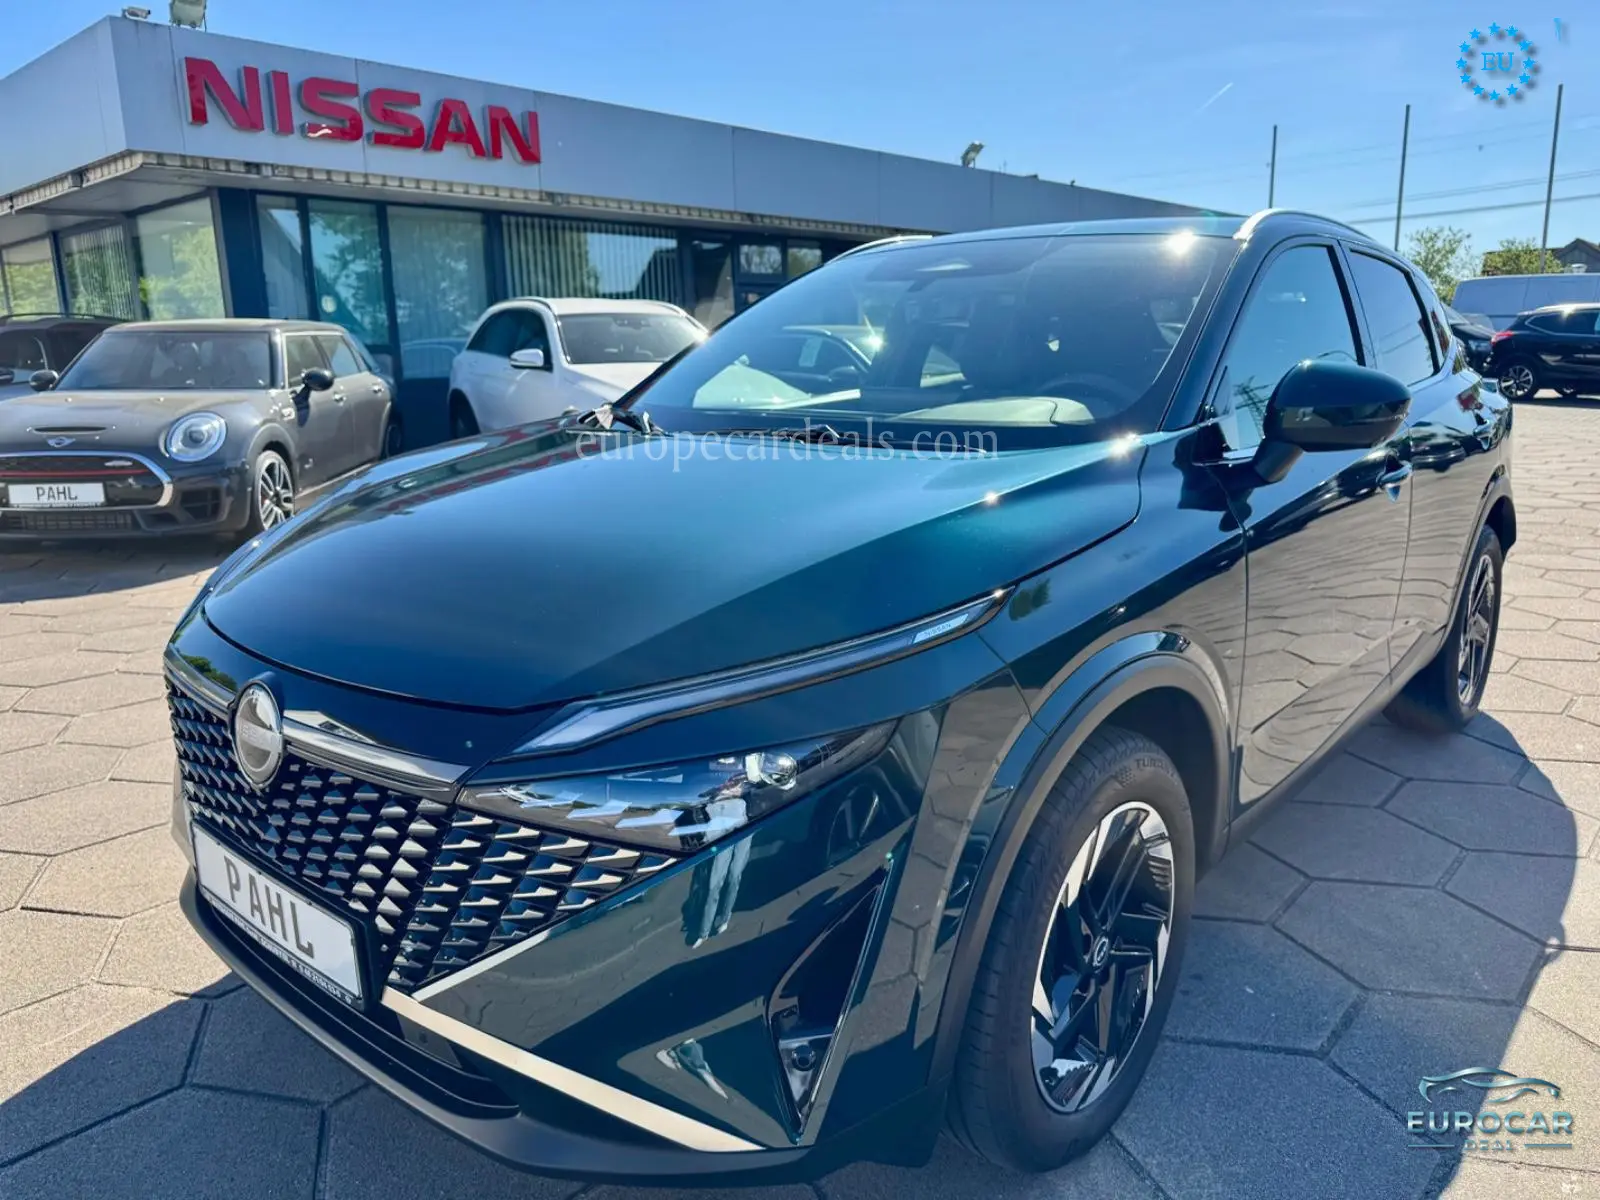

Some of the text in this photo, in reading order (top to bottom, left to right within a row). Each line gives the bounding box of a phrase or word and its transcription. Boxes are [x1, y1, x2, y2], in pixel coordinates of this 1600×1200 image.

[181, 56, 542, 165] NISSAN
[36, 486, 78, 501] PAHL
[223, 854, 315, 960] PAHL
